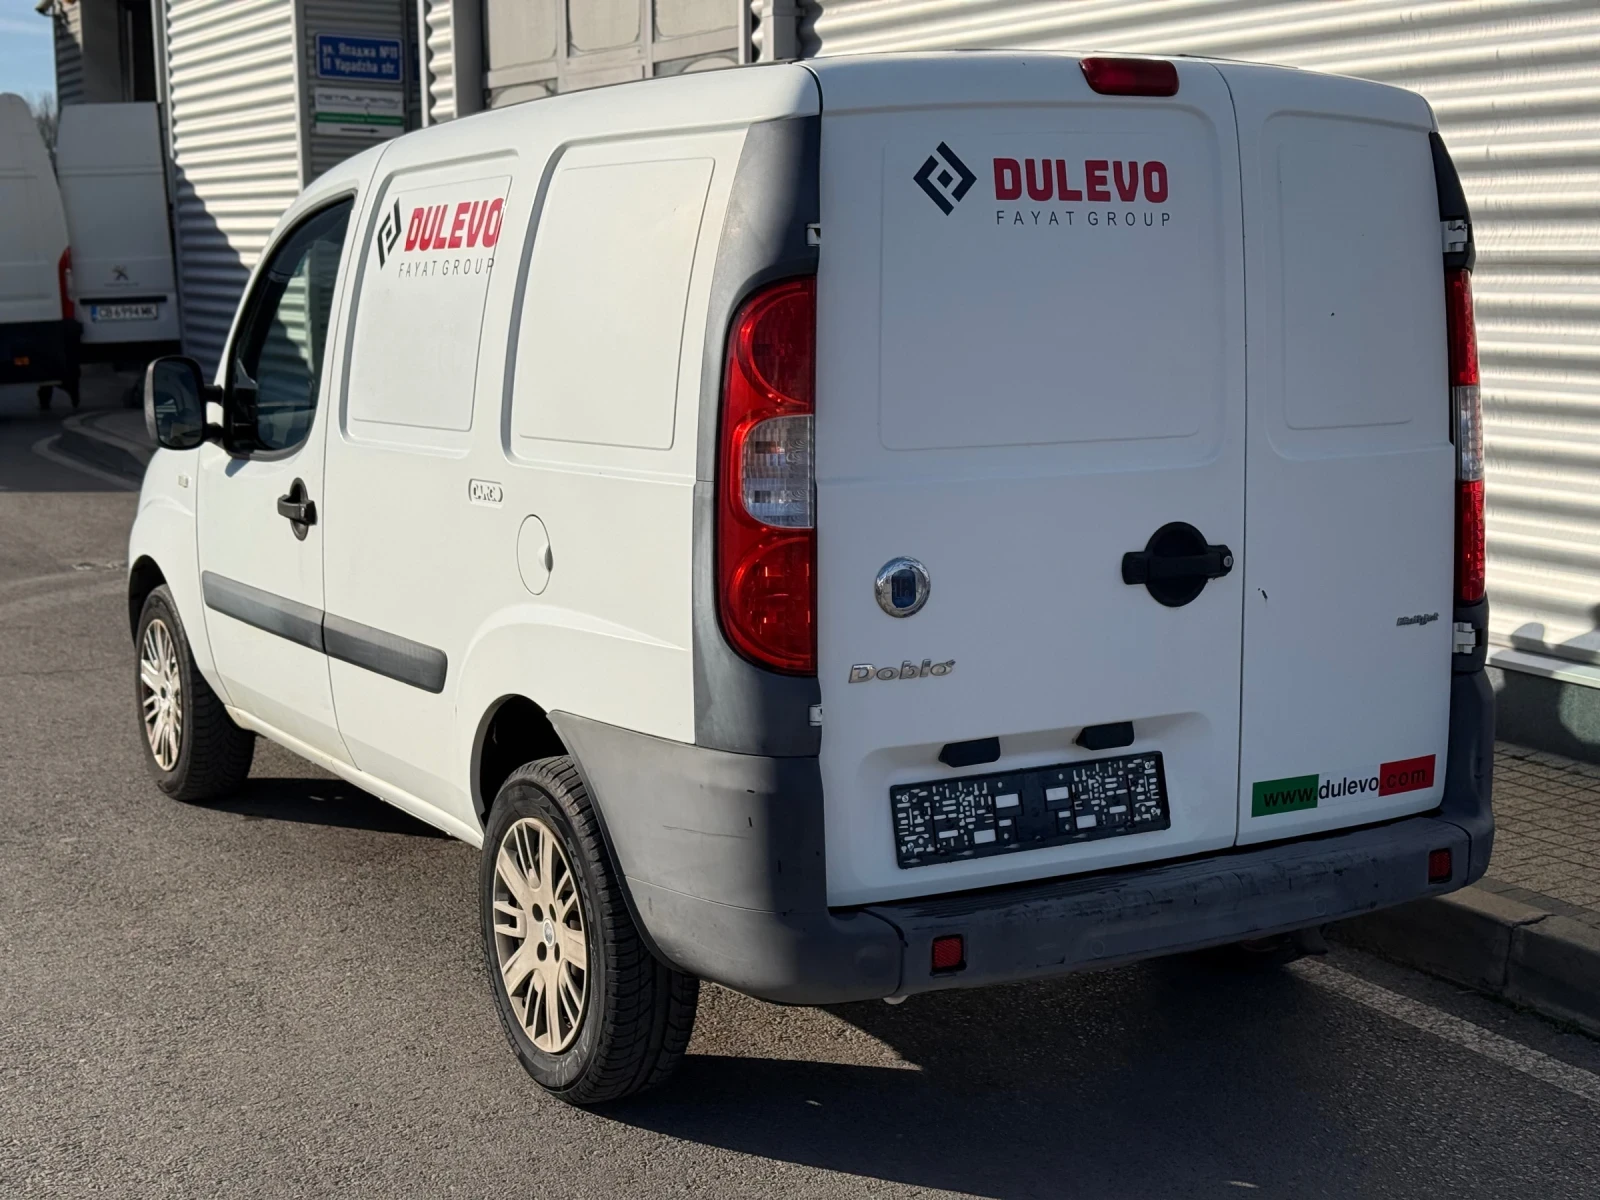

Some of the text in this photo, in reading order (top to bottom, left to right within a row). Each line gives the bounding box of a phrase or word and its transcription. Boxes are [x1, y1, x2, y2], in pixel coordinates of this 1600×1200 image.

[992, 158, 1169, 203] DULEVO
[404, 197, 504, 252] DULEVO
[996, 210, 1171, 227] FAYAT GROUP
[398, 257, 494, 279] FAYAT GROUP
[1263, 768, 1426, 808] www.dulevo.com
